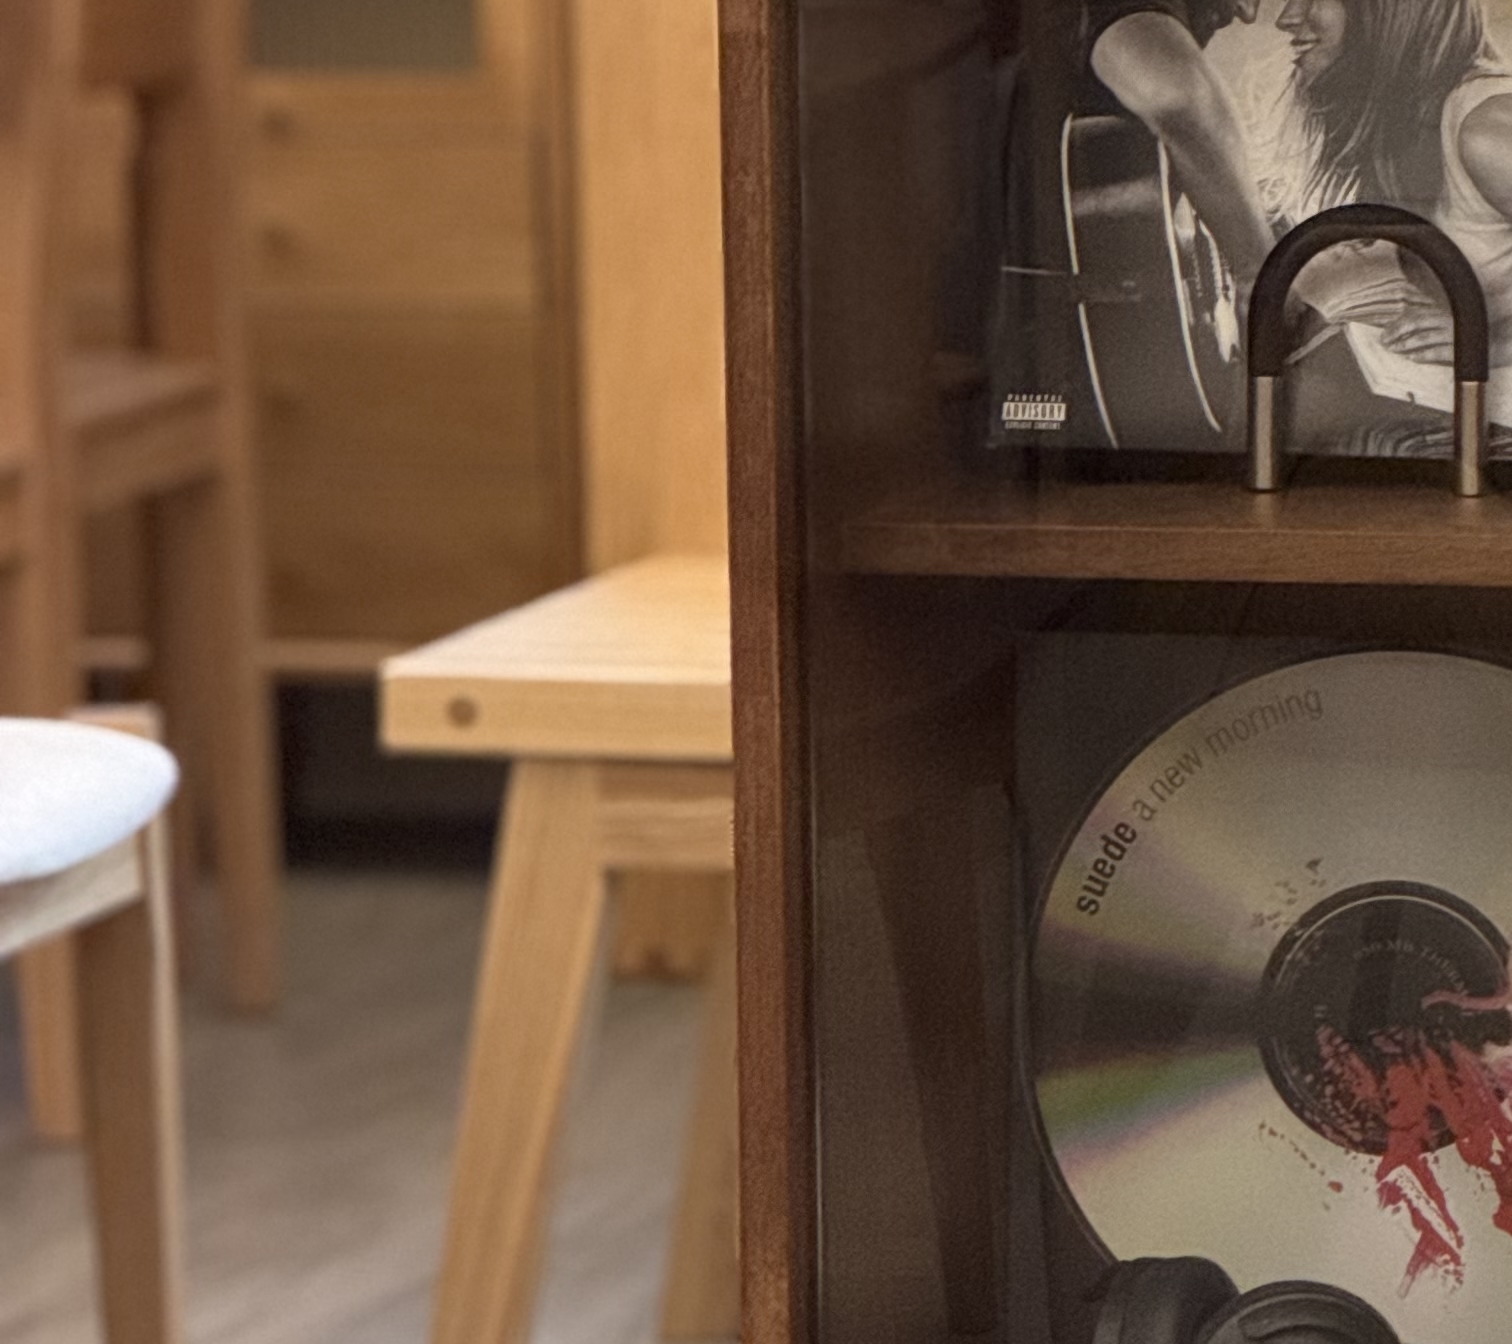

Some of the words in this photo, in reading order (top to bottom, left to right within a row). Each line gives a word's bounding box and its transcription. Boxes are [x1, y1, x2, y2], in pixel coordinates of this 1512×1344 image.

[1005, 403, 1063, 419] ADVISORY
[1076, 820, 1137, 916] suede
[1132, 798, 1158, 822] a
[1150, 746, 1204, 804] new
[1205, 688, 1324, 755] morning
